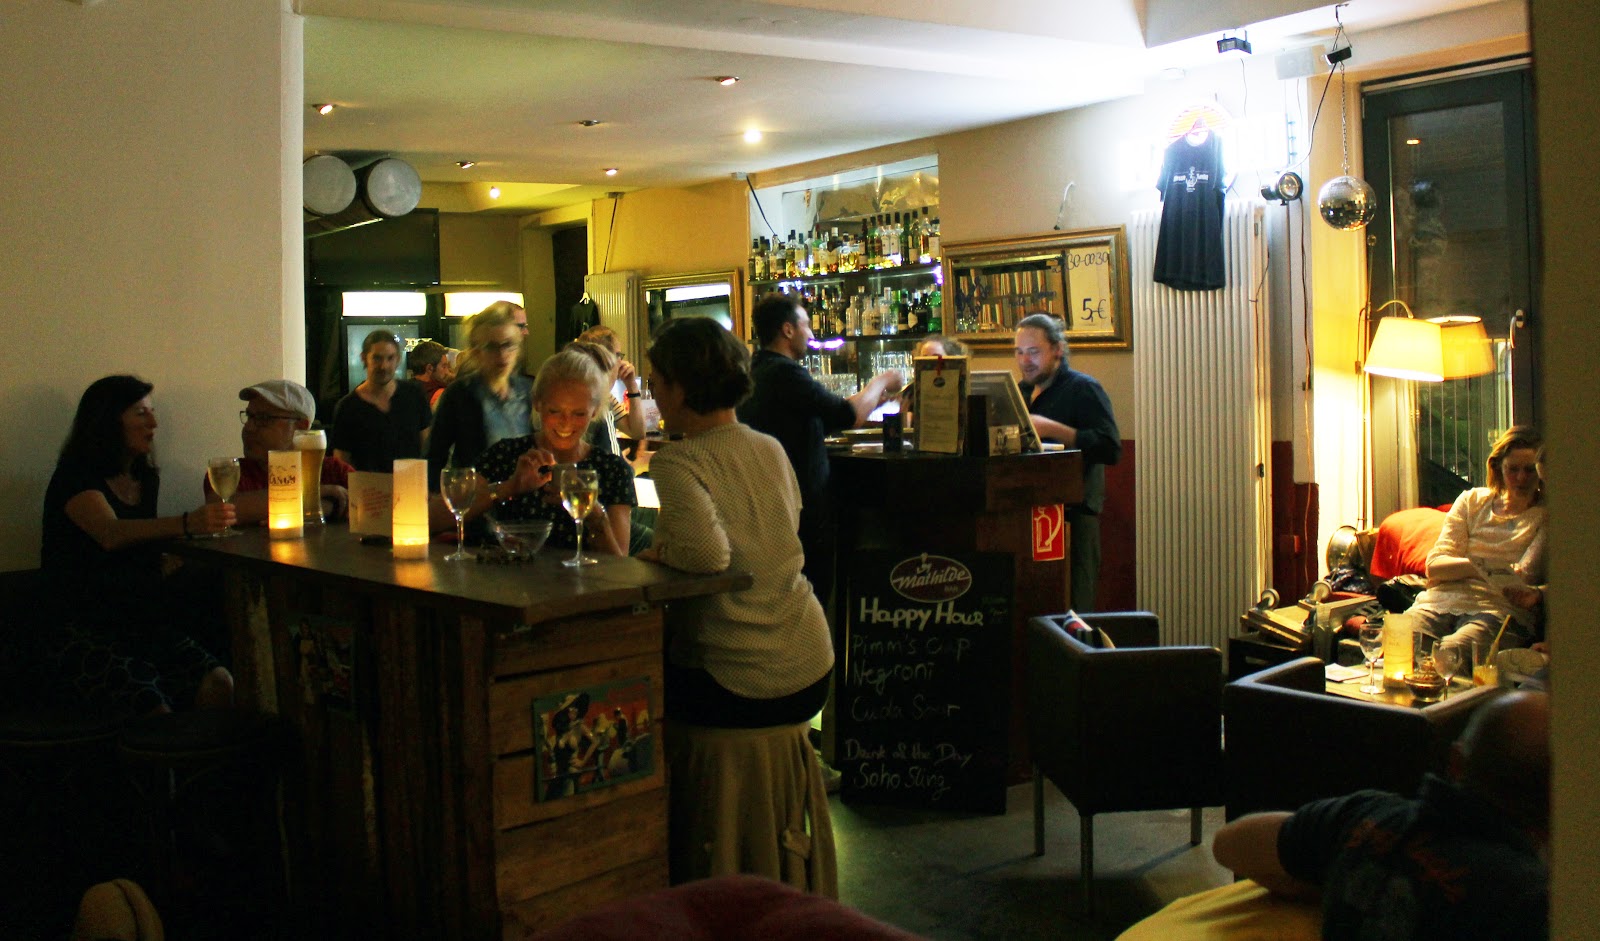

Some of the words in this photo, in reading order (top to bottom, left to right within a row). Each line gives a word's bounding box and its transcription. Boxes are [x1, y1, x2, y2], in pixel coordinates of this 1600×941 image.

[859, 596, 932, 632] Happy
[851, 633, 919, 657] Pimm's
[852, 658, 936, 697] Negroni
[858, 762, 902, 790] Soho
